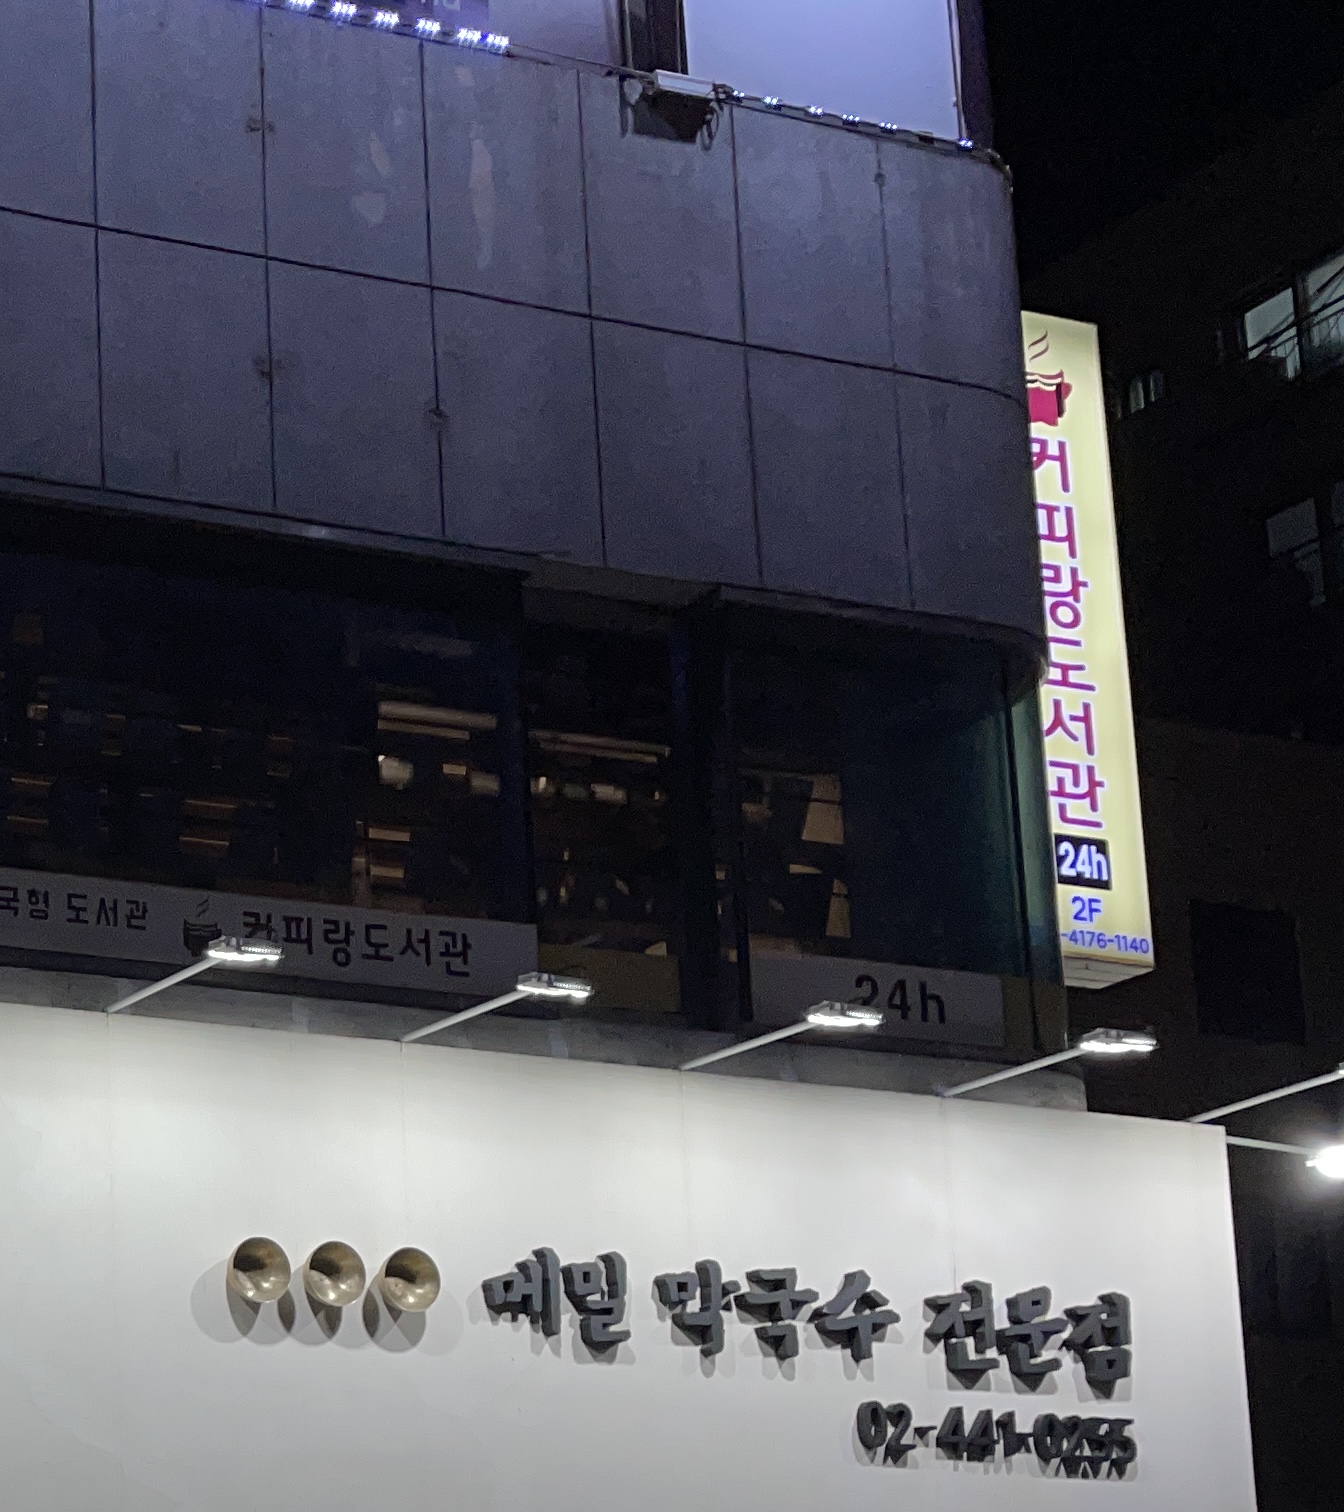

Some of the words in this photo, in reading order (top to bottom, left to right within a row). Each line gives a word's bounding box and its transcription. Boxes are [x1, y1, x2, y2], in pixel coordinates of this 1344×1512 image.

[1058, 840, 1110, 882] 24h
[66, 892, 149, 931] 도서관
[1071, 895, 1103, 924] 2F
[241, 909, 473, 978] 커피랑도서관
[853, 973, 947, 1025] 24h
[480, 1246, 632, 1355] 메밀
[652, 1258, 902, 1362] 막국수
[923, 1279, 1134, 1399] 전문점
[857, 1400, 1138, 1480] 02-441-0255
